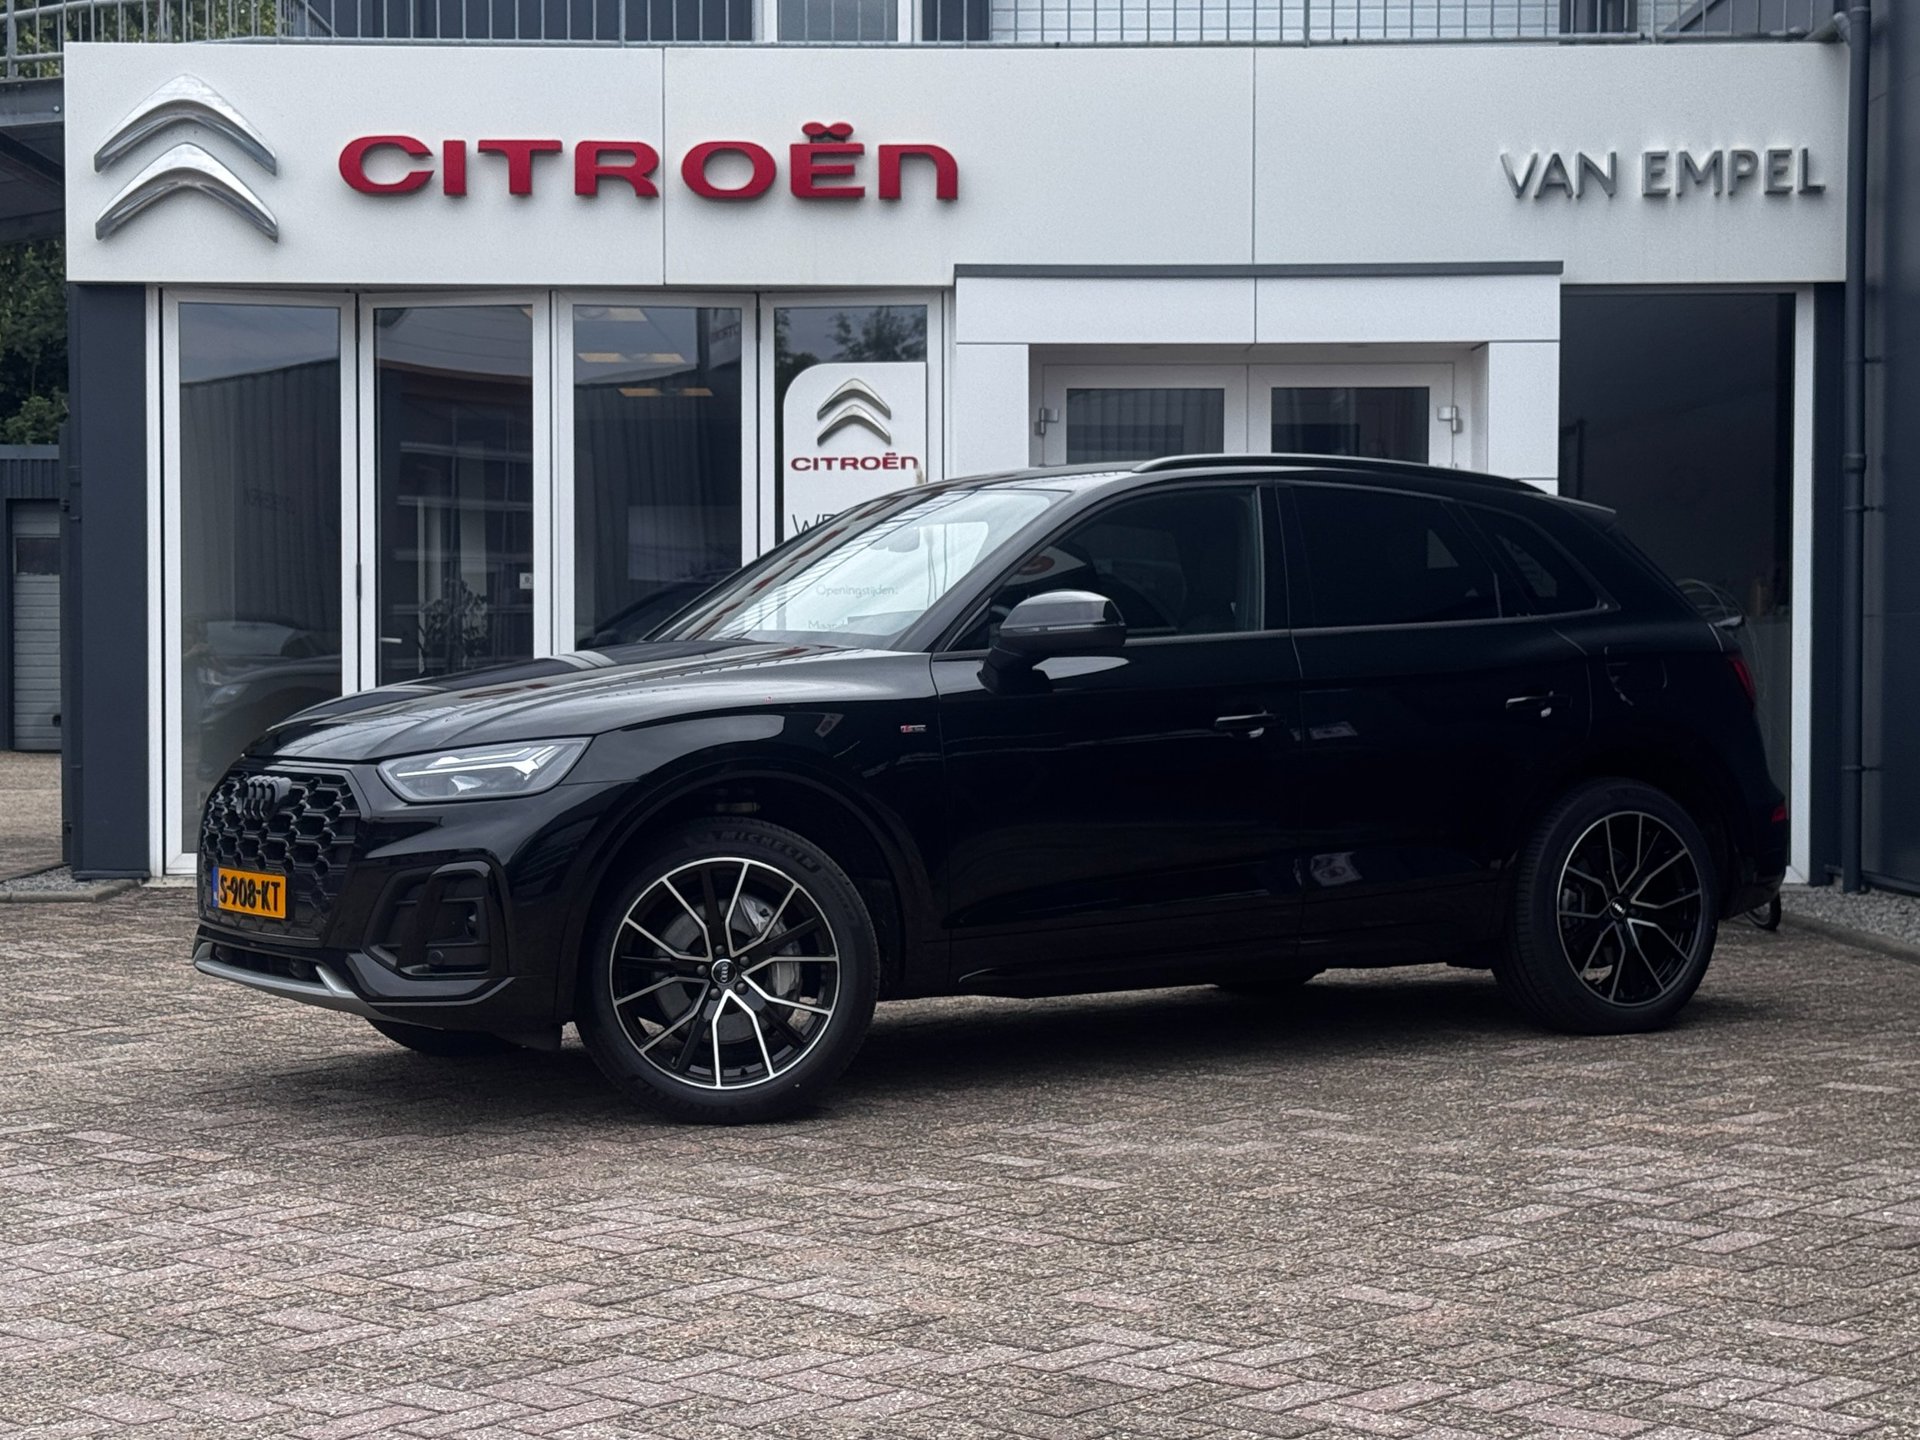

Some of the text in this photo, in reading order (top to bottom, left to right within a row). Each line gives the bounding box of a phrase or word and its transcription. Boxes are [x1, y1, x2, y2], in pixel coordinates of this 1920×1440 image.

[1499, 147, 1827, 200] VAN EMPEL
[219, 874, 281, 912] S-908-KT
